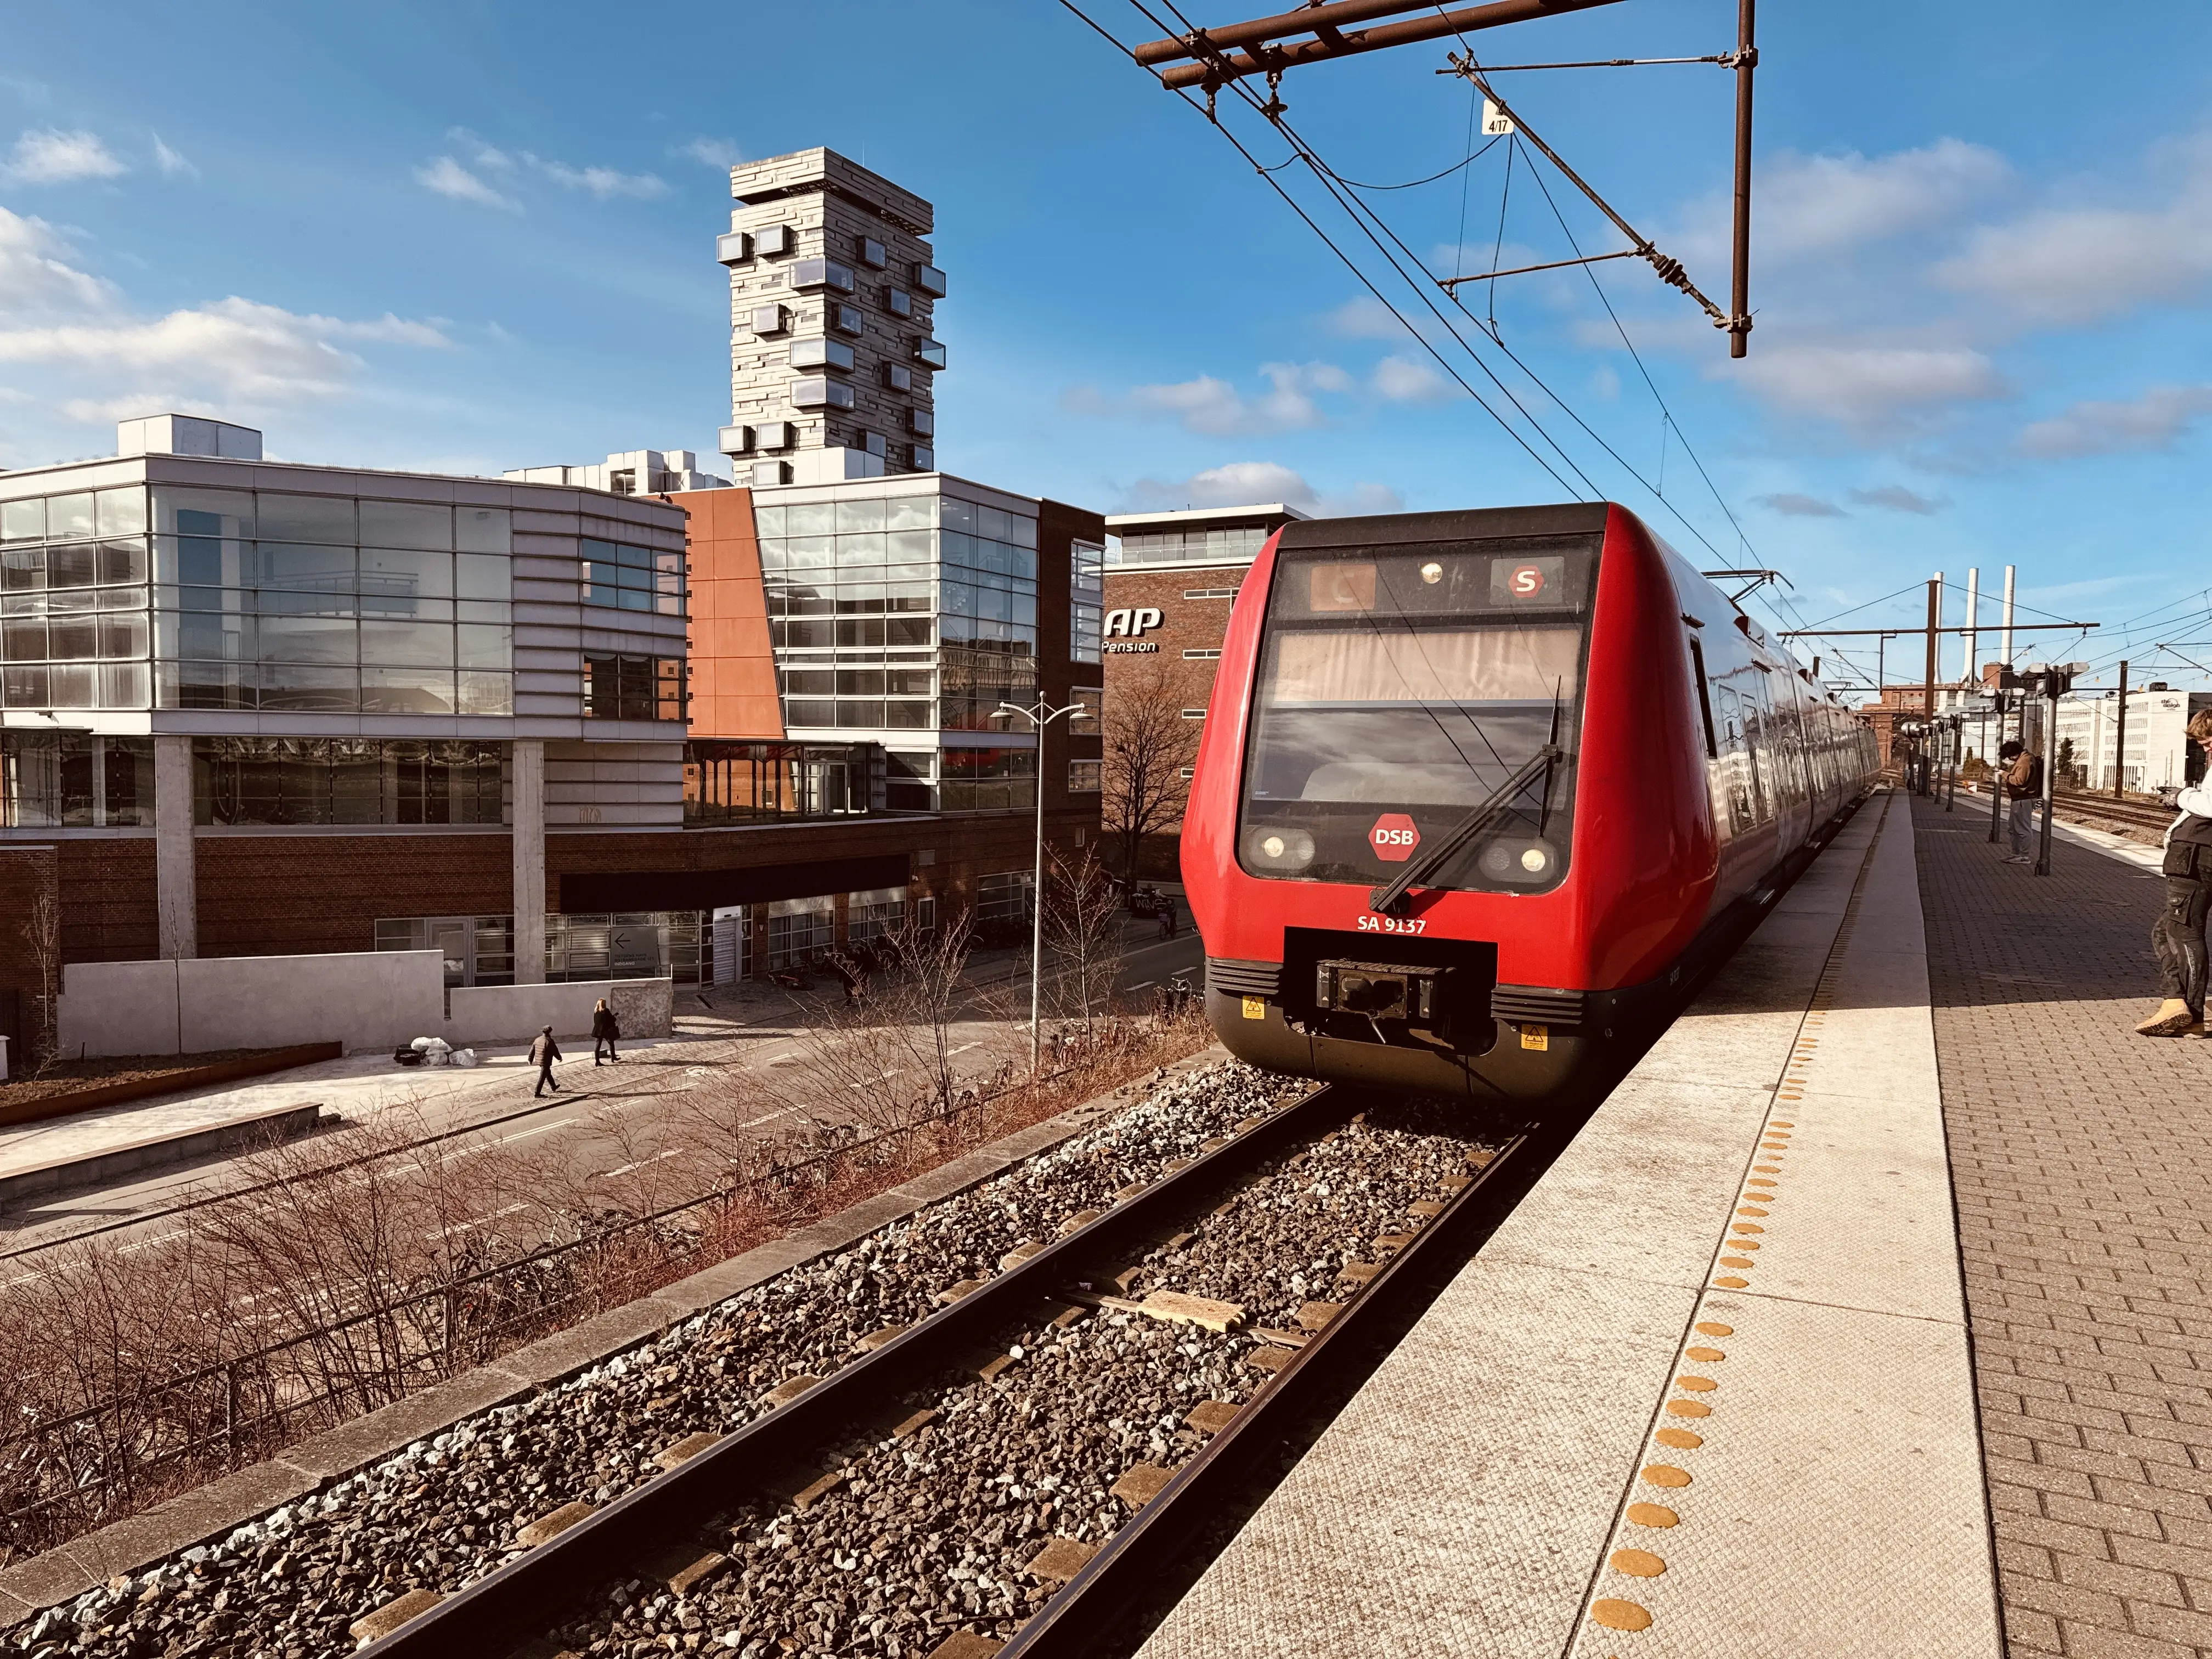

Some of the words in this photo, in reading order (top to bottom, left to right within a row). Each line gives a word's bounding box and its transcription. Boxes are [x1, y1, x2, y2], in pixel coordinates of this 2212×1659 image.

[1489, 120, 1508, 132] 4/17
[1331, 572, 1354, 603] C
[1516, 571, 1536, 592] S
[1104, 608, 1160, 636] AP
[1102, 641, 1155, 652] Pension
[1375, 829, 1414, 845] DSB
[1357, 916, 1380, 931] SA
[1385, 917, 1426, 934] 9137
